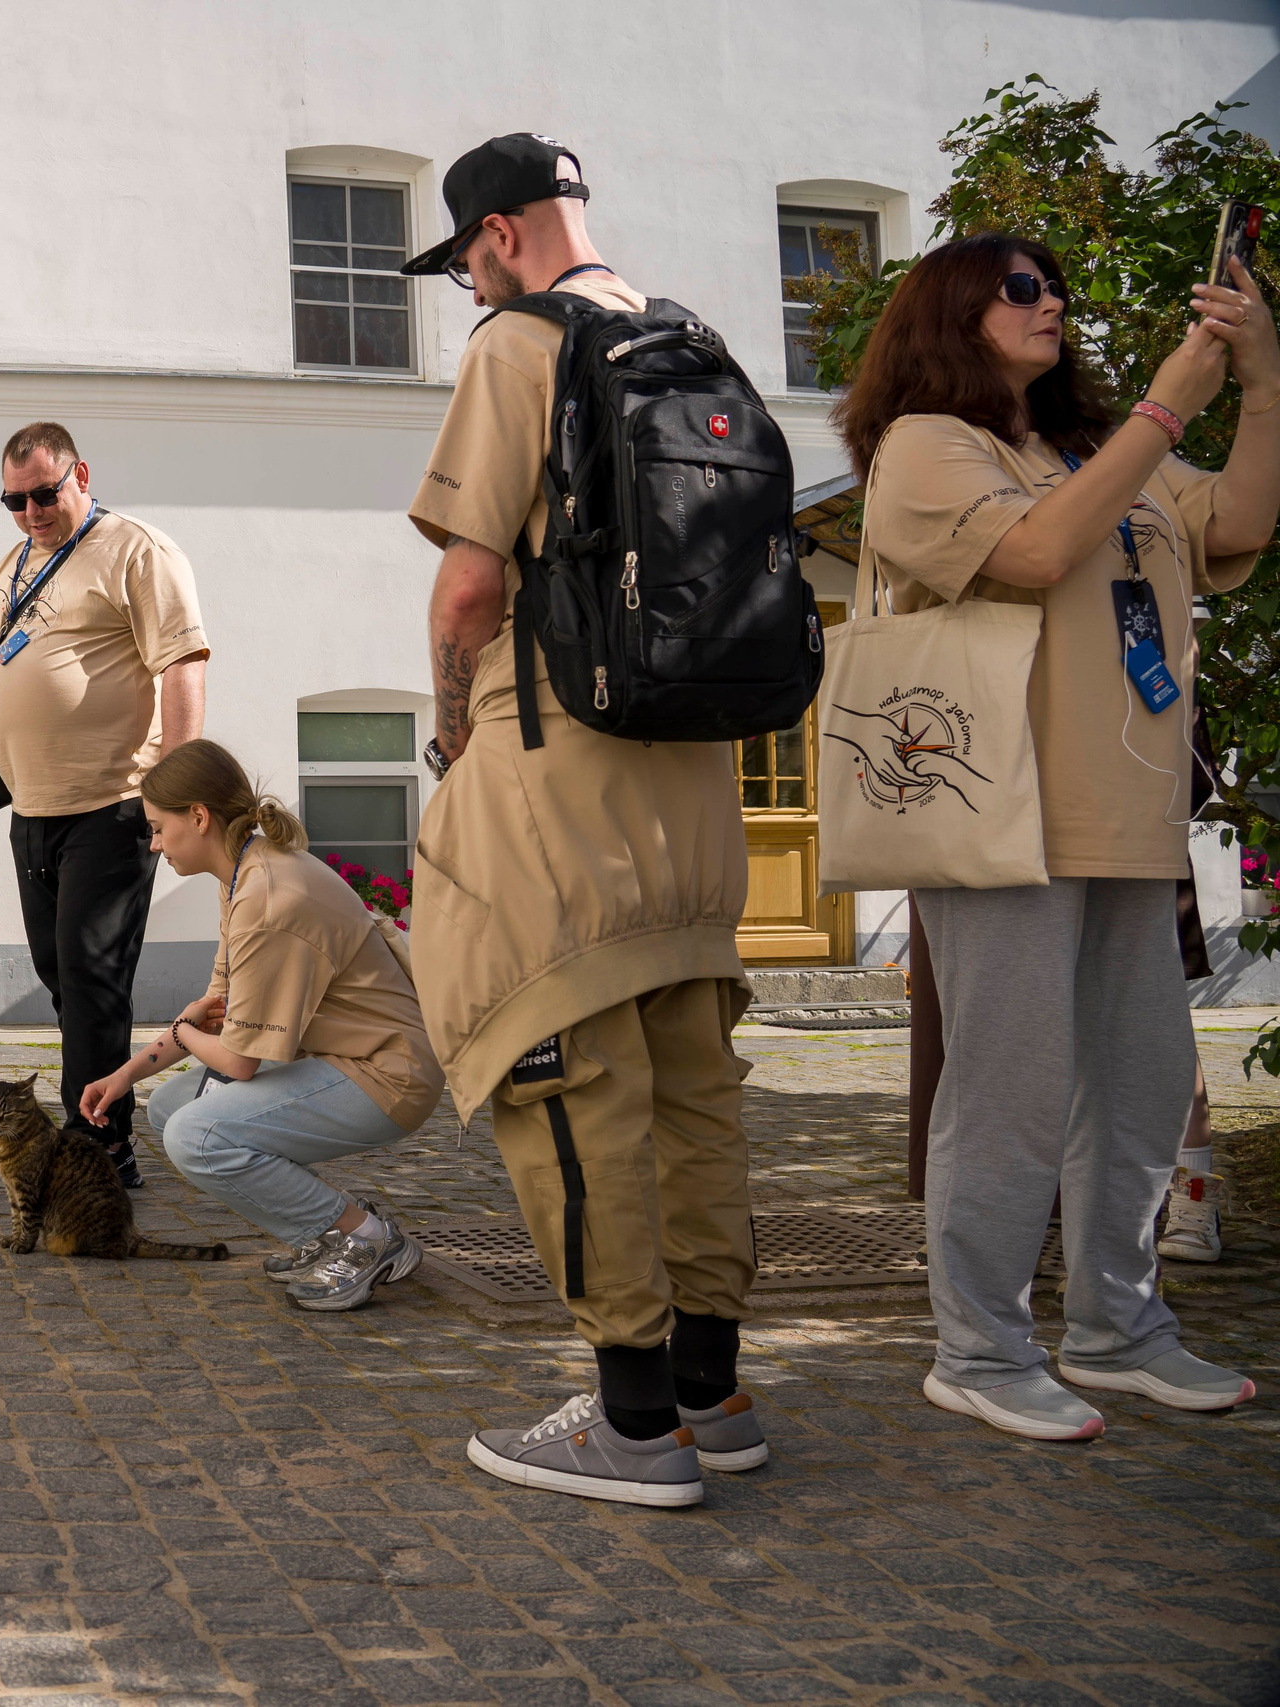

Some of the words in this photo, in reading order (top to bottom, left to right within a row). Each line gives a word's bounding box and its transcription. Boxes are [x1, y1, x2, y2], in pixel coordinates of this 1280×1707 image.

[428, 471, 462, 490] лапы
[955, 494, 992, 528] четыре
[992, 487, 1020, 497] лапы
[878, 686, 944, 709] навигатор
[945, 702, 975, 755] заботы
[859, 779, 869, 802] четыре
[868, 799, 884, 810] лапы
[918, 793, 936, 808] 2026
[233, 1019, 264, 1031] четыре
[264, 1023, 287, 1033] лапы
